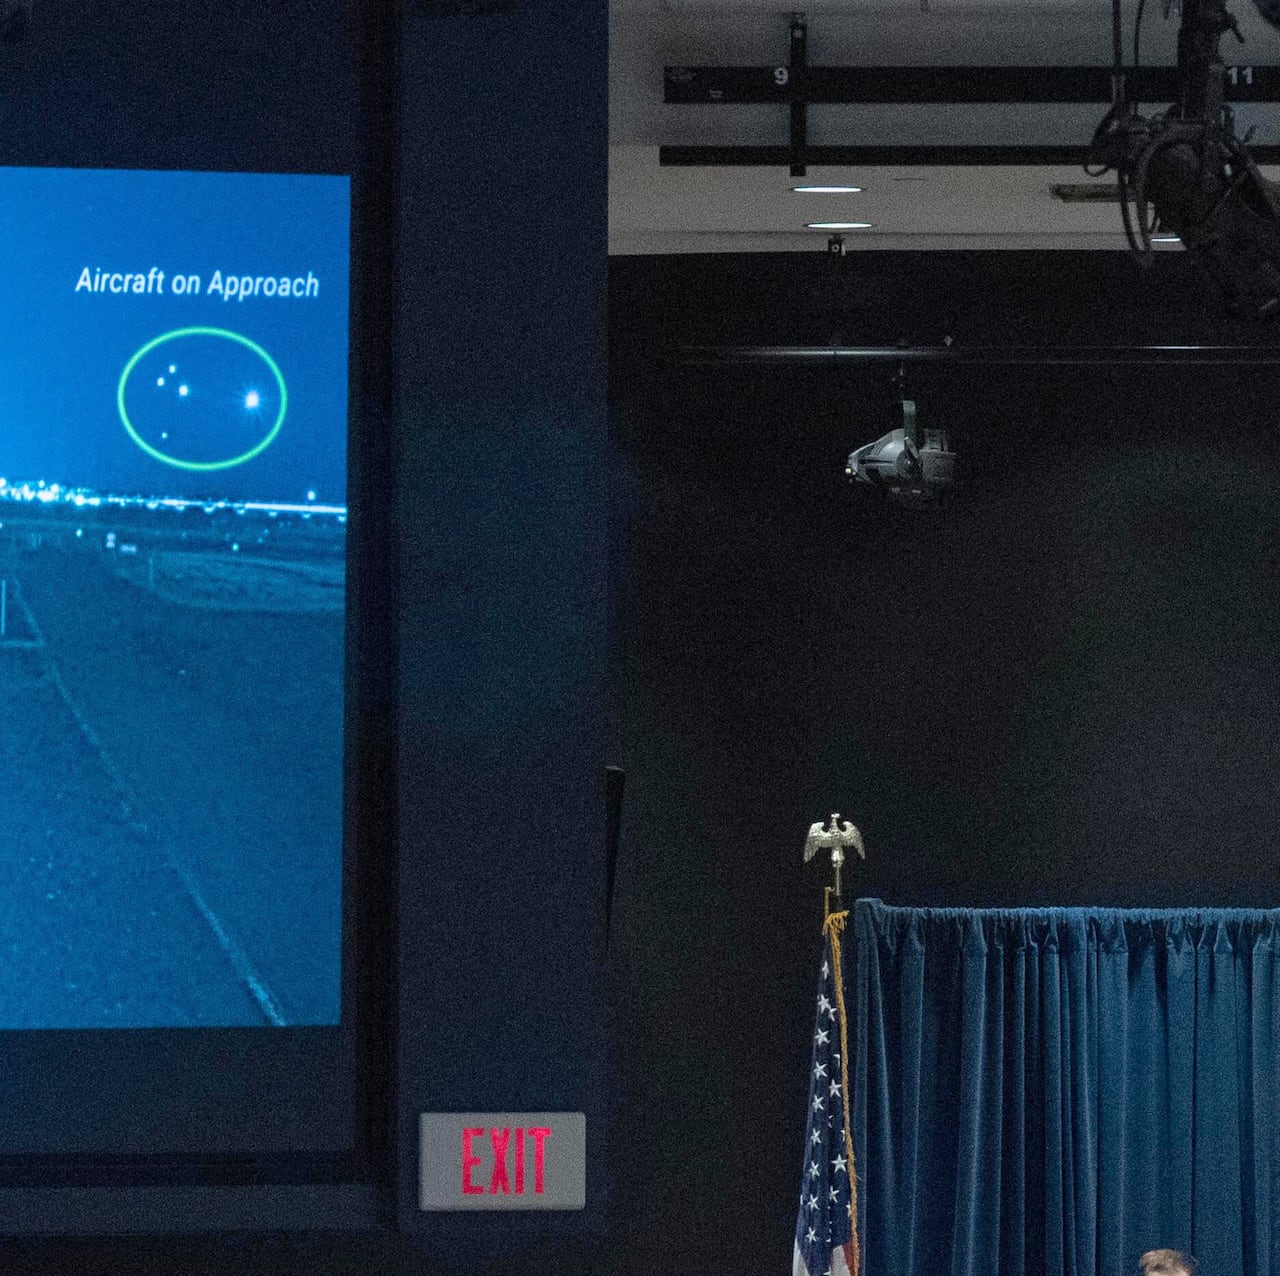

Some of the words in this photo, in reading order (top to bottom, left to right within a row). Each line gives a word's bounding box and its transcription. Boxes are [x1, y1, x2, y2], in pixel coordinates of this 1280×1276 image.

[774, 67, 789, 85] 9
[1227, 66, 1253, 84] 11
[74, 266, 166, 294] Aircraft
[171, 274, 201, 295] on
[206, 269, 320, 302] Approach
[461, 1127, 552, 1195] EXIT
